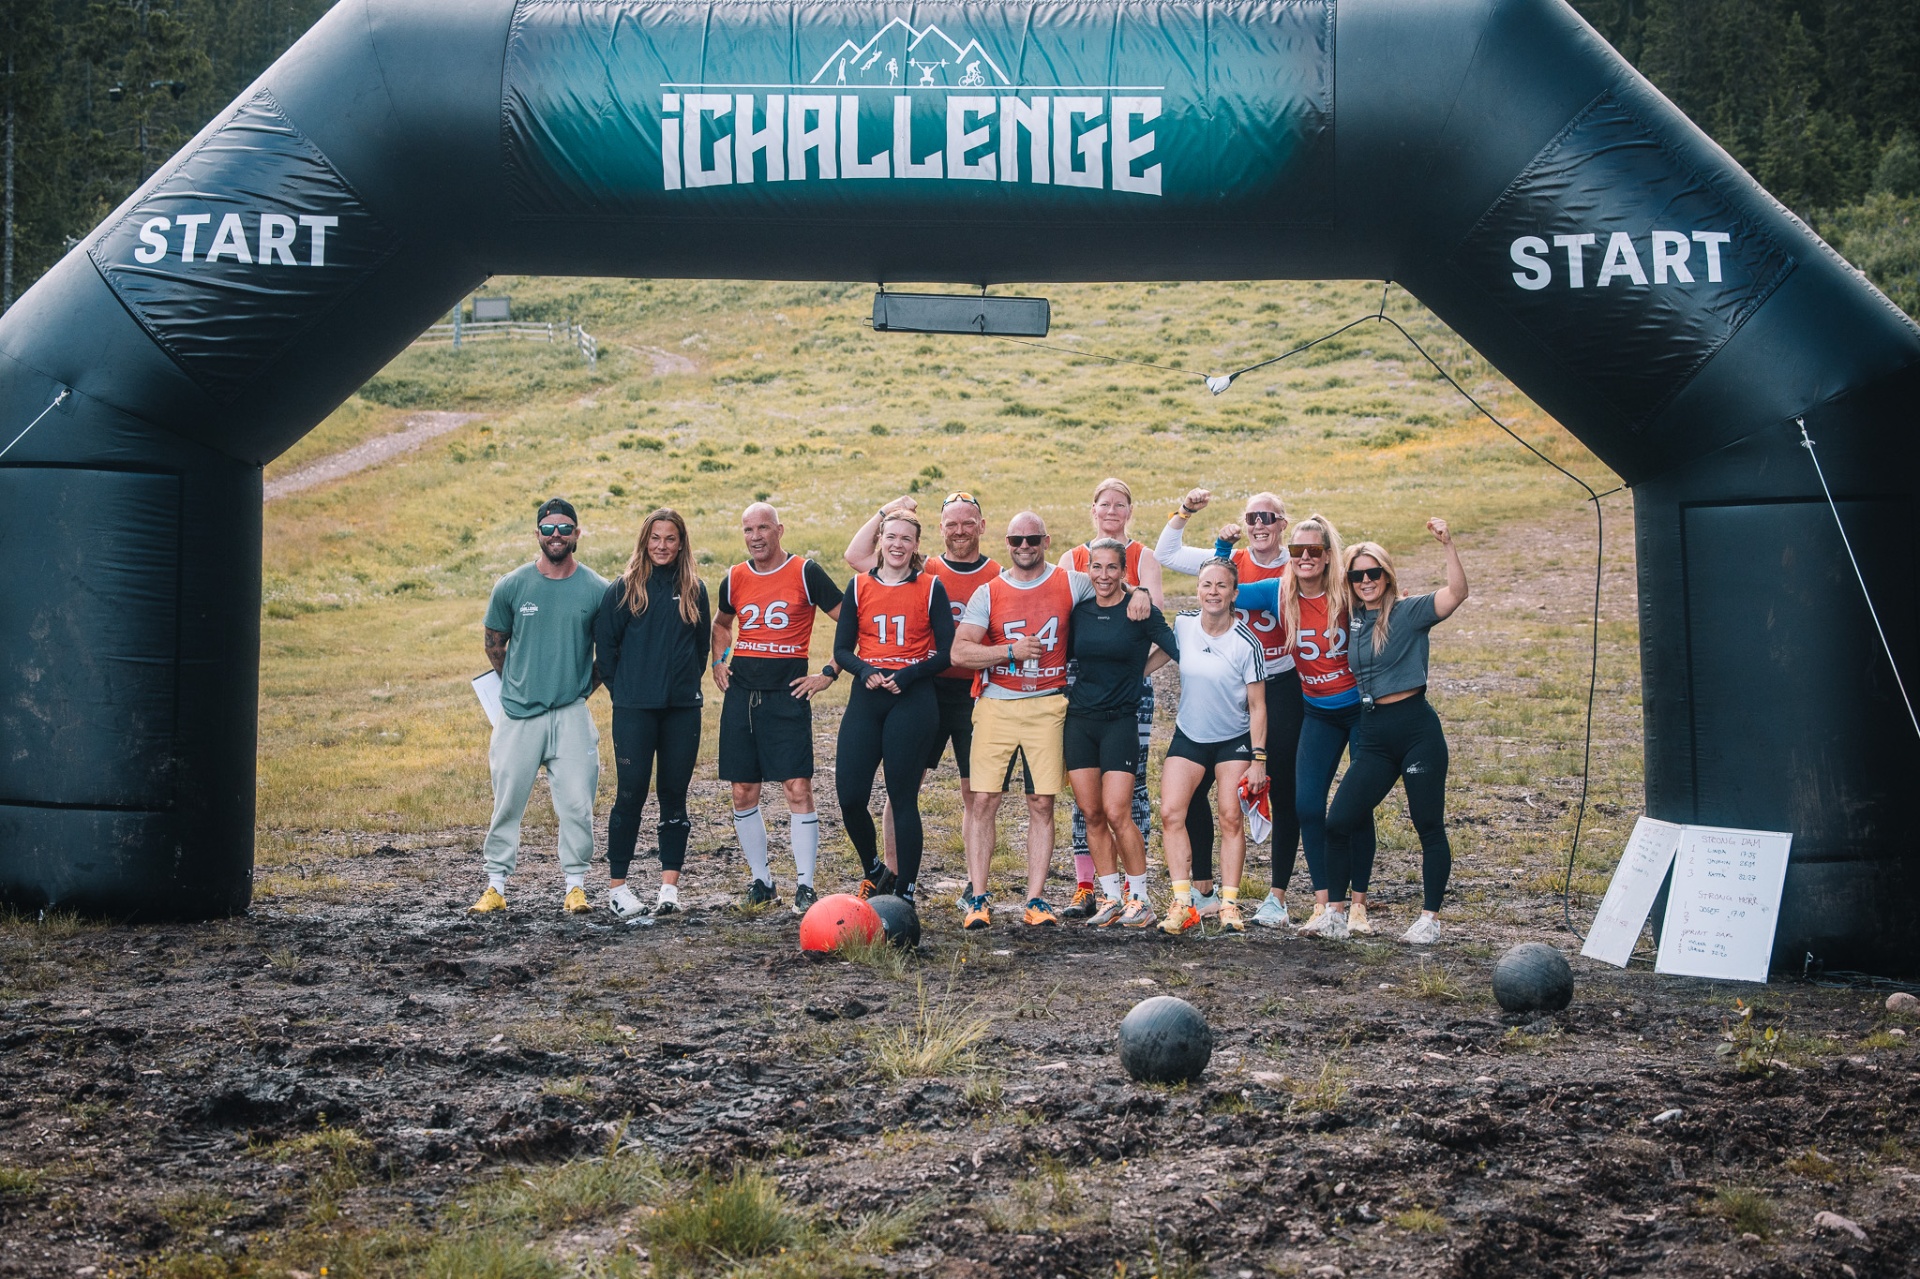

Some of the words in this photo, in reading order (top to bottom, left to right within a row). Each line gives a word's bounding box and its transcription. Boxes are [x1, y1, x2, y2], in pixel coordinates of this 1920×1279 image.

[661, 93, 1163, 196] iCHALLENGE
[134, 213, 339, 267] START
[1510, 230, 1731, 290] START
[739, 600, 790, 631] 26
[872, 613, 906, 647] 11
[1002, 615, 1059, 652] 54
[1295, 628, 1348, 661] 52
[1691, 844, 1696, 853] 1
[1701, 835, 1736, 845] STRONG
[1741, 837, 1761, 848] DAM
[1687, 869, 1694, 878] 3
[1689, 857, 1695, 865] 2
[1698, 890, 1733, 901] STRONG
